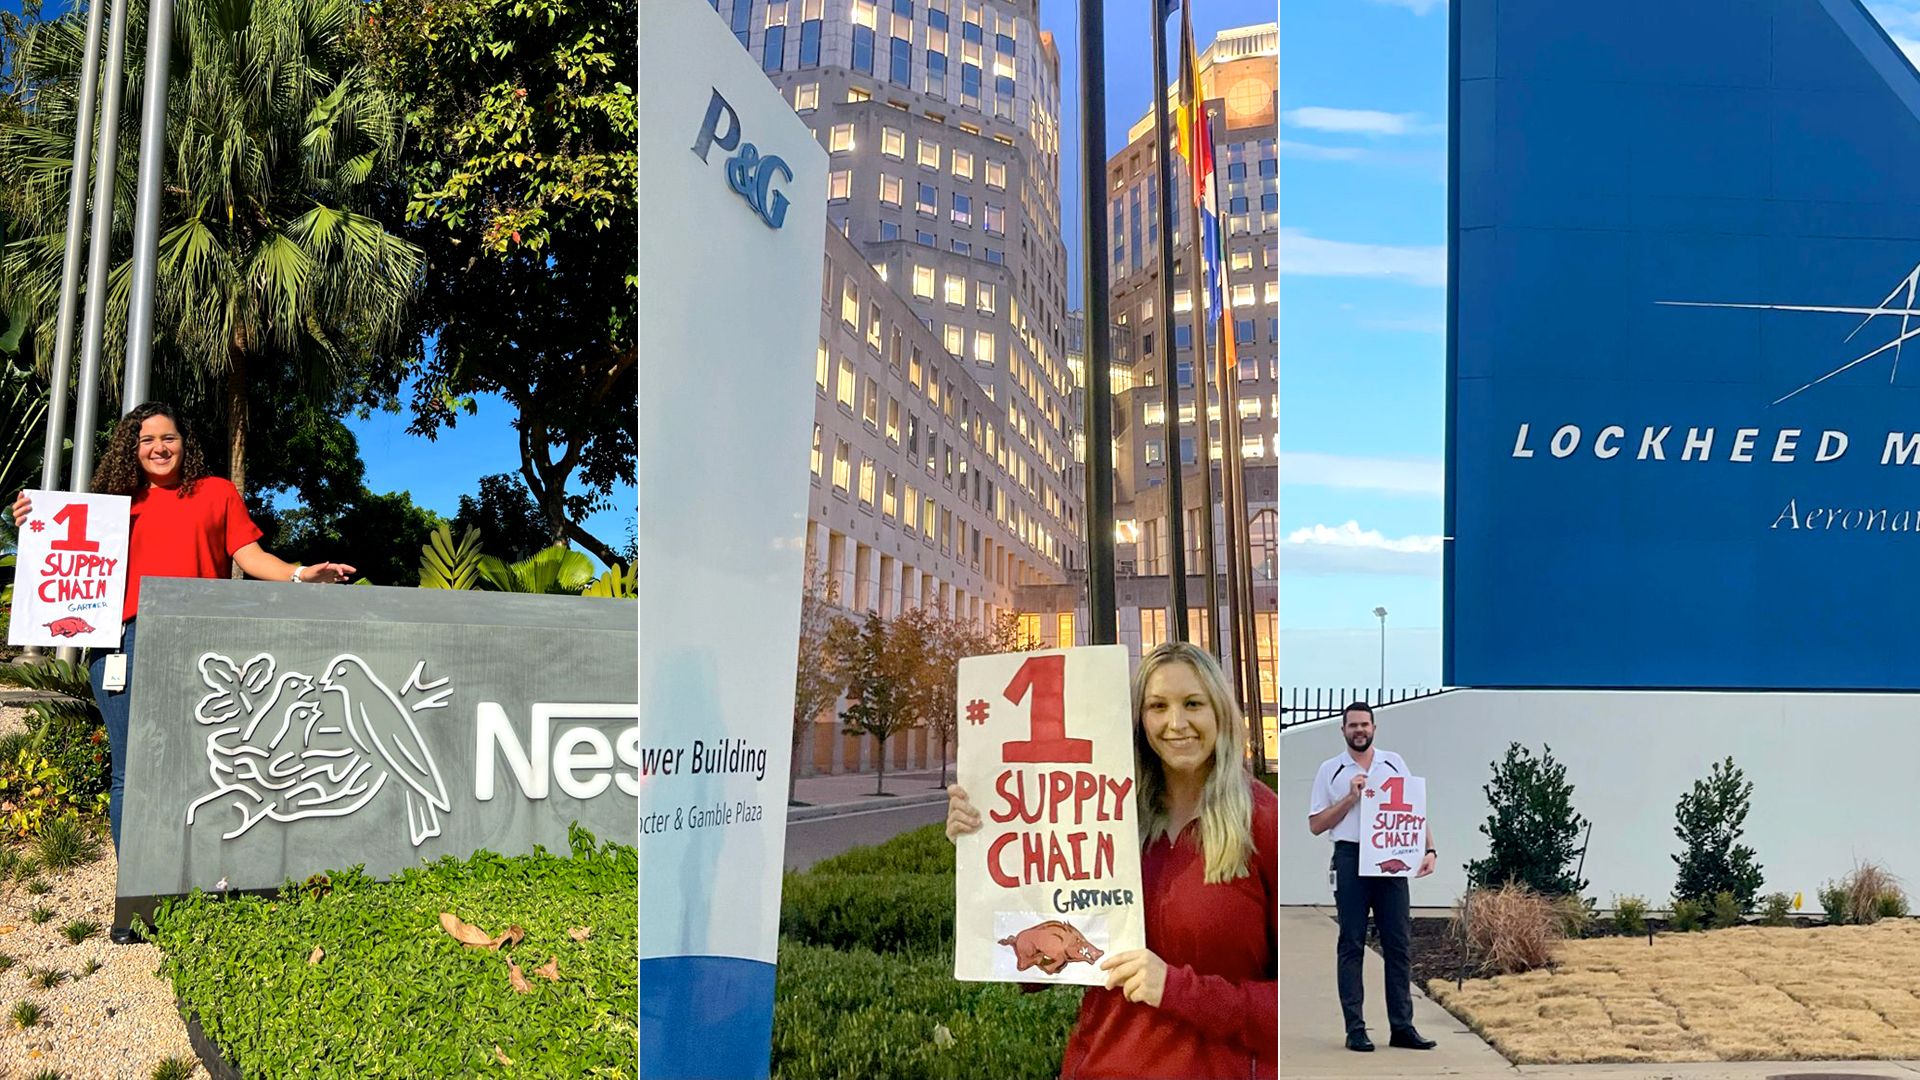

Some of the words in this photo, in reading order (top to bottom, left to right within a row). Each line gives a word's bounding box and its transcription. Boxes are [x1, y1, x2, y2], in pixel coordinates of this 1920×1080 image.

[690, 86, 794, 229] P&G
[1511, 423, 1849, 462] LOCKHEED
[40, 553, 118, 577] SUPPLY
[38, 579, 107, 603] CHAIN
[642, 748, 684, 776] wer
[691, 739, 767, 781] Building
[989, 769, 1134, 825] SUPPLY
[674, 807, 683, 830] &
[688, 801, 732, 829] Gamble
[735, 799, 763, 824] Plaza
[1372, 813, 1426, 831] SUPPLY
[1371, 831, 1419, 849] CHAIN
[987, 830, 1114, 888] CHAIN
[1053, 888, 1134, 914] GARTNER
